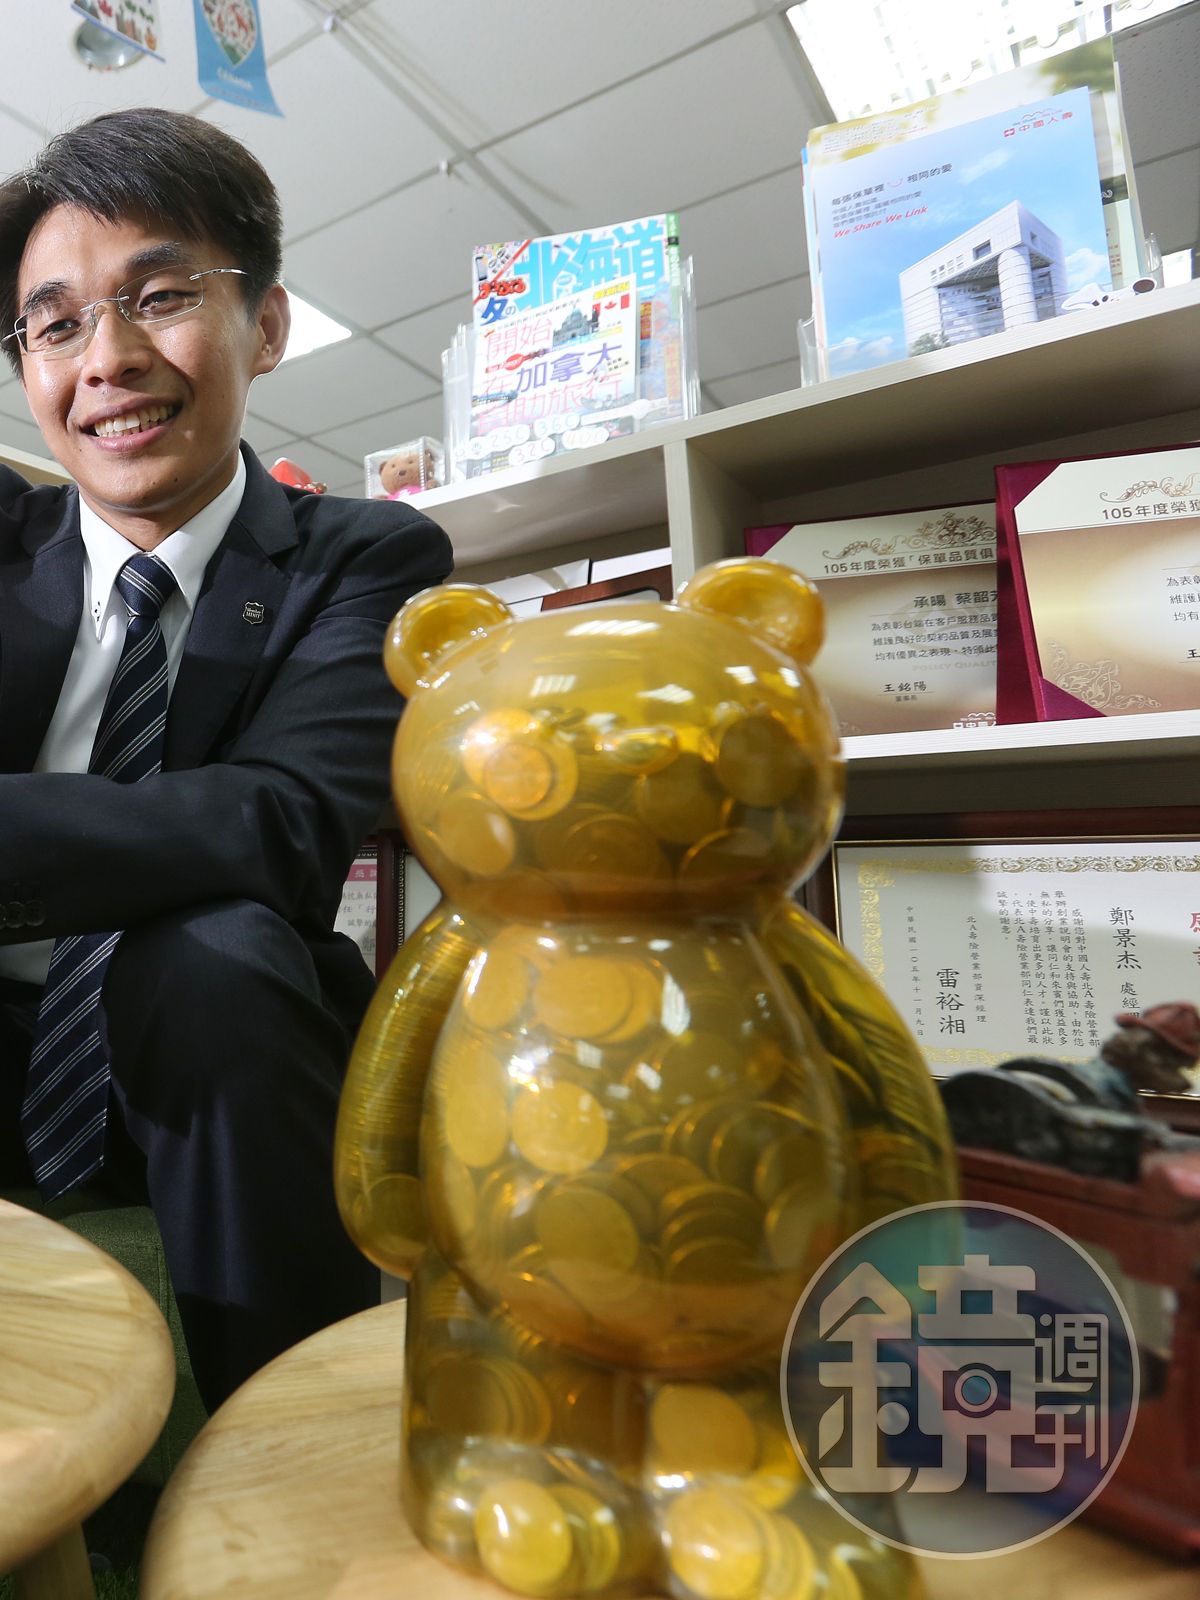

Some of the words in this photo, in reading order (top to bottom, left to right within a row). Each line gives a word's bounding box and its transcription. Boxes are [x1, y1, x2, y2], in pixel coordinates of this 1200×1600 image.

[834, 229, 851, 238] We
[852, 219, 882, 233] Share
[885, 212, 902, 223] We
[905, 205, 928, 219] Link
[514, 218, 665, 313] 北海道
[487, 319, 551, 361] 開始
[1169, 593, 1200, 605] 維護
[1174, 611, 1199, 622] 均有
[1109, 906, 1142, 969] 鄭景杰
[935, 967, 965, 1035] 雷裕湘
